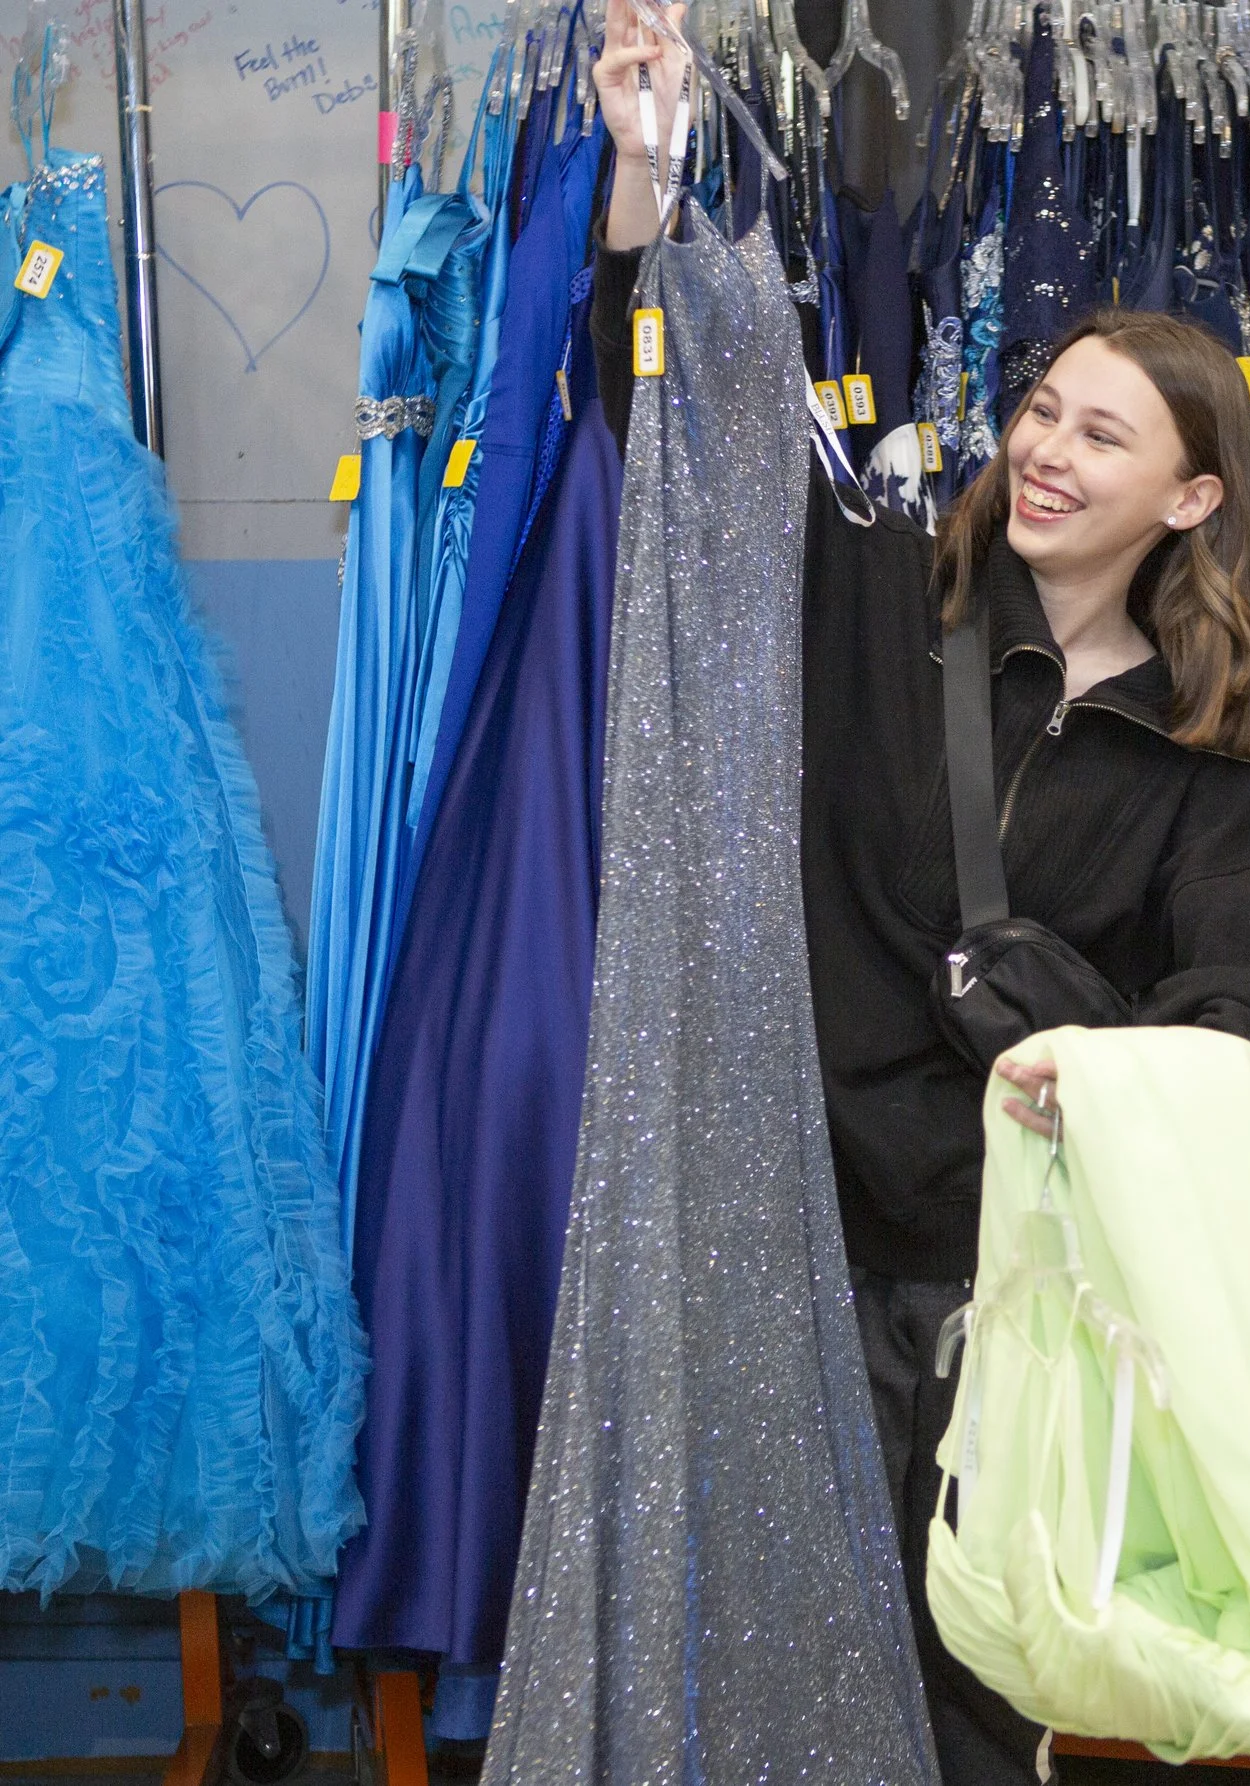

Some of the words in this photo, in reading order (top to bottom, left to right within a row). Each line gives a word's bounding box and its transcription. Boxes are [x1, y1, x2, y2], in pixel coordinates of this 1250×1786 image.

[234, 43, 280, 82] Feel
[281, 34, 321, 63] the
[28, 255, 48, 285] 2574
[642, 325, 653, 362] 0831
[824, 392, 839, 422] 0392
[853, 386, 866, 416] 0393
